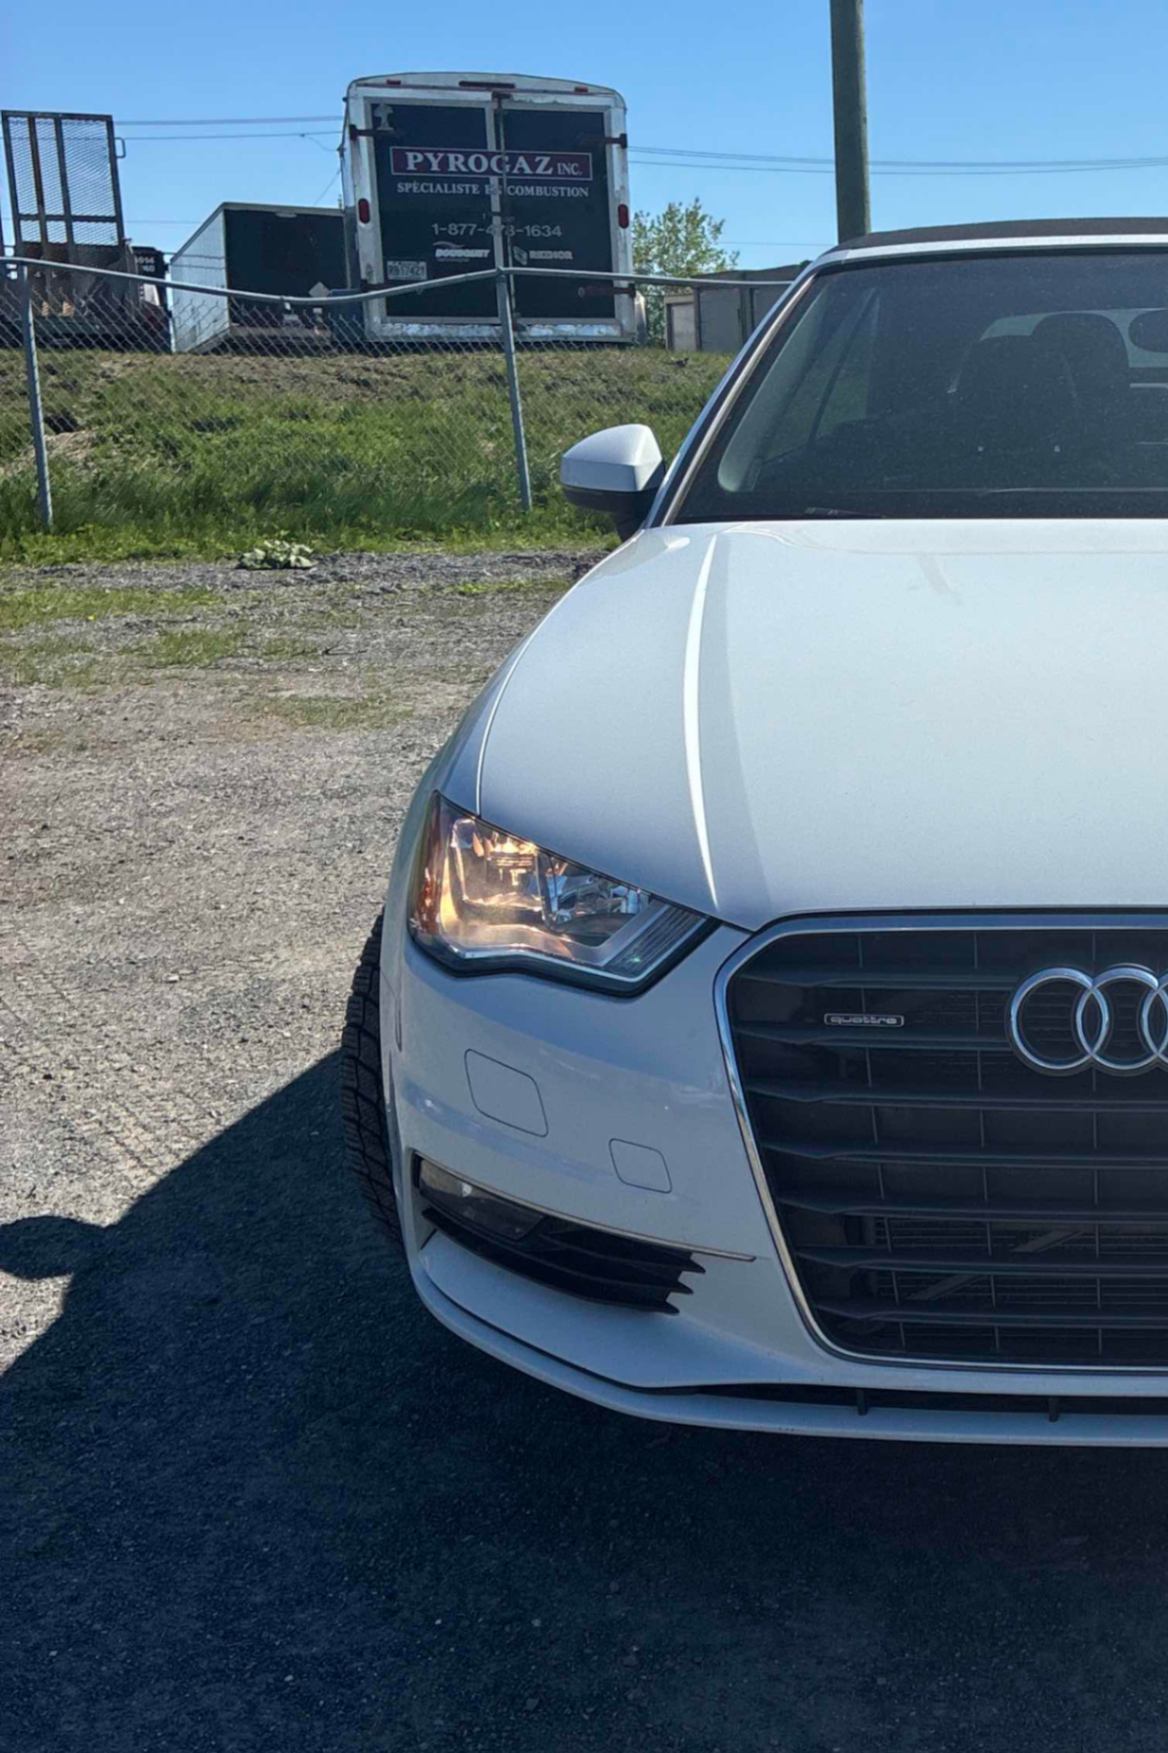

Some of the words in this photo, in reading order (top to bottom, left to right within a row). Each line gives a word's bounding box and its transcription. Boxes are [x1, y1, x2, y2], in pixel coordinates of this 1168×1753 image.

[405, 151, 553, 175] PYROGAZ
[557, 162, 583, 176] INC.
[507, 185, 589, 197] COMBUSTION
[829, 1015, 899, 1025] quattro
